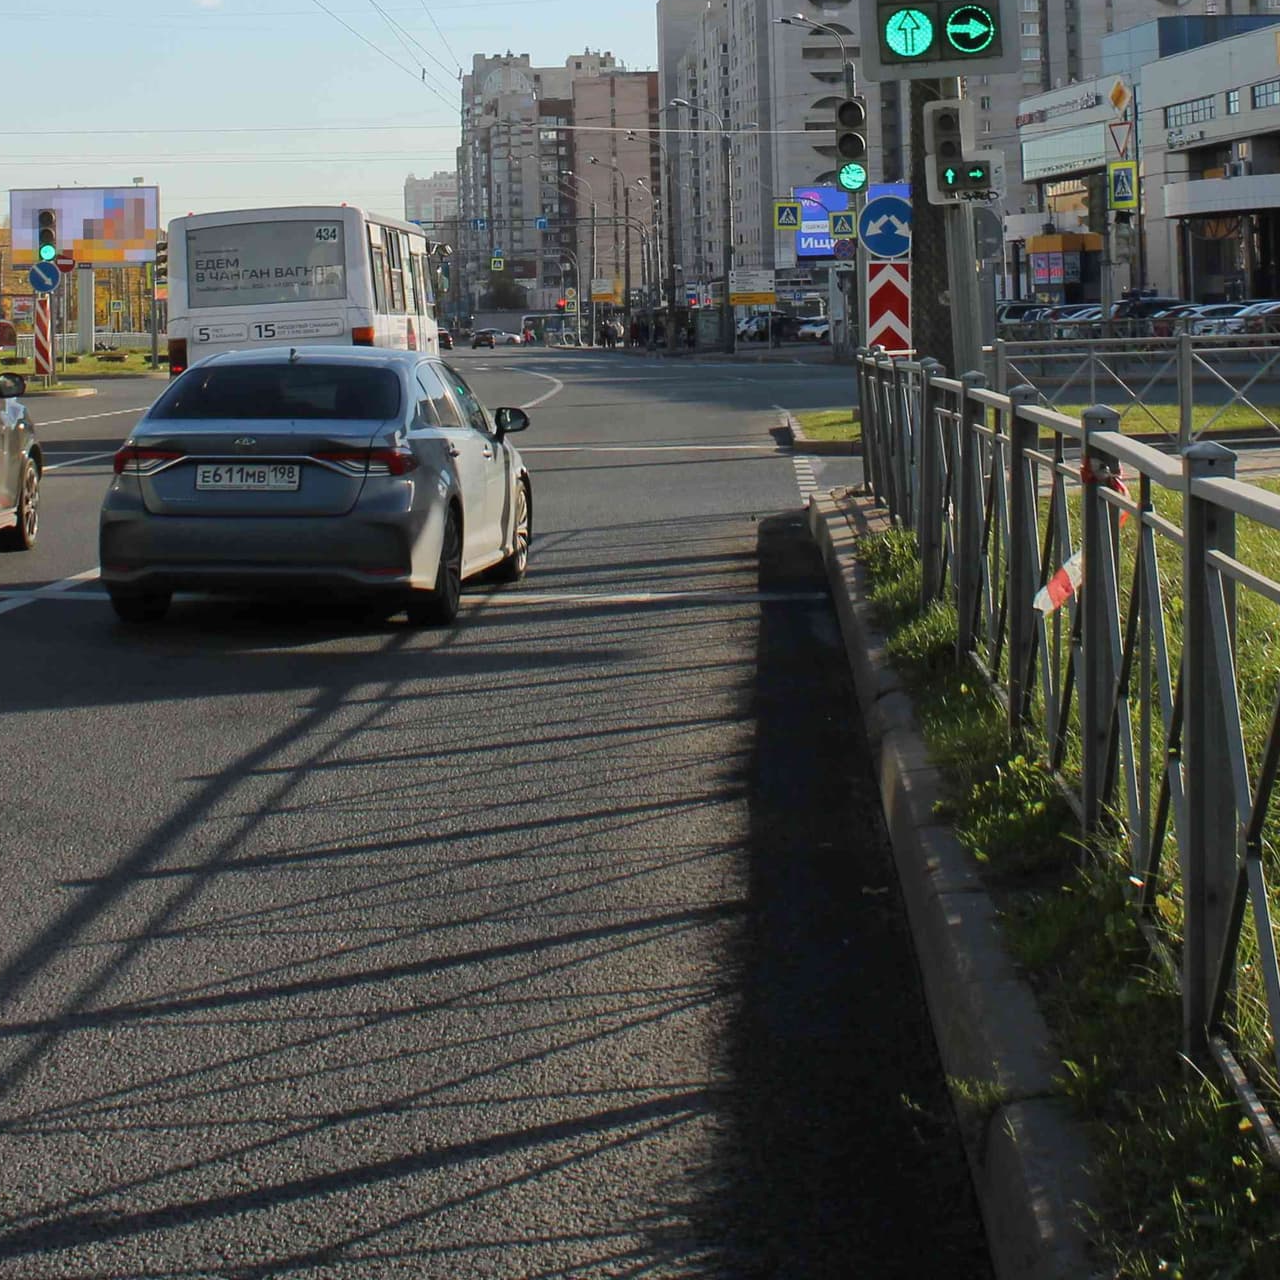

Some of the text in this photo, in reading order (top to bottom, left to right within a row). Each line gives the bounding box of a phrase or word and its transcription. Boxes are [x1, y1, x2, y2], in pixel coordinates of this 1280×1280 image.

[315, 228, 337, 241] 434
[195, 258, 239, 271] ЕДЕМ
[196, 272, 205, 282] В
[199, 327, 210, 342] 5
[254, 324, 276, 338] 15
